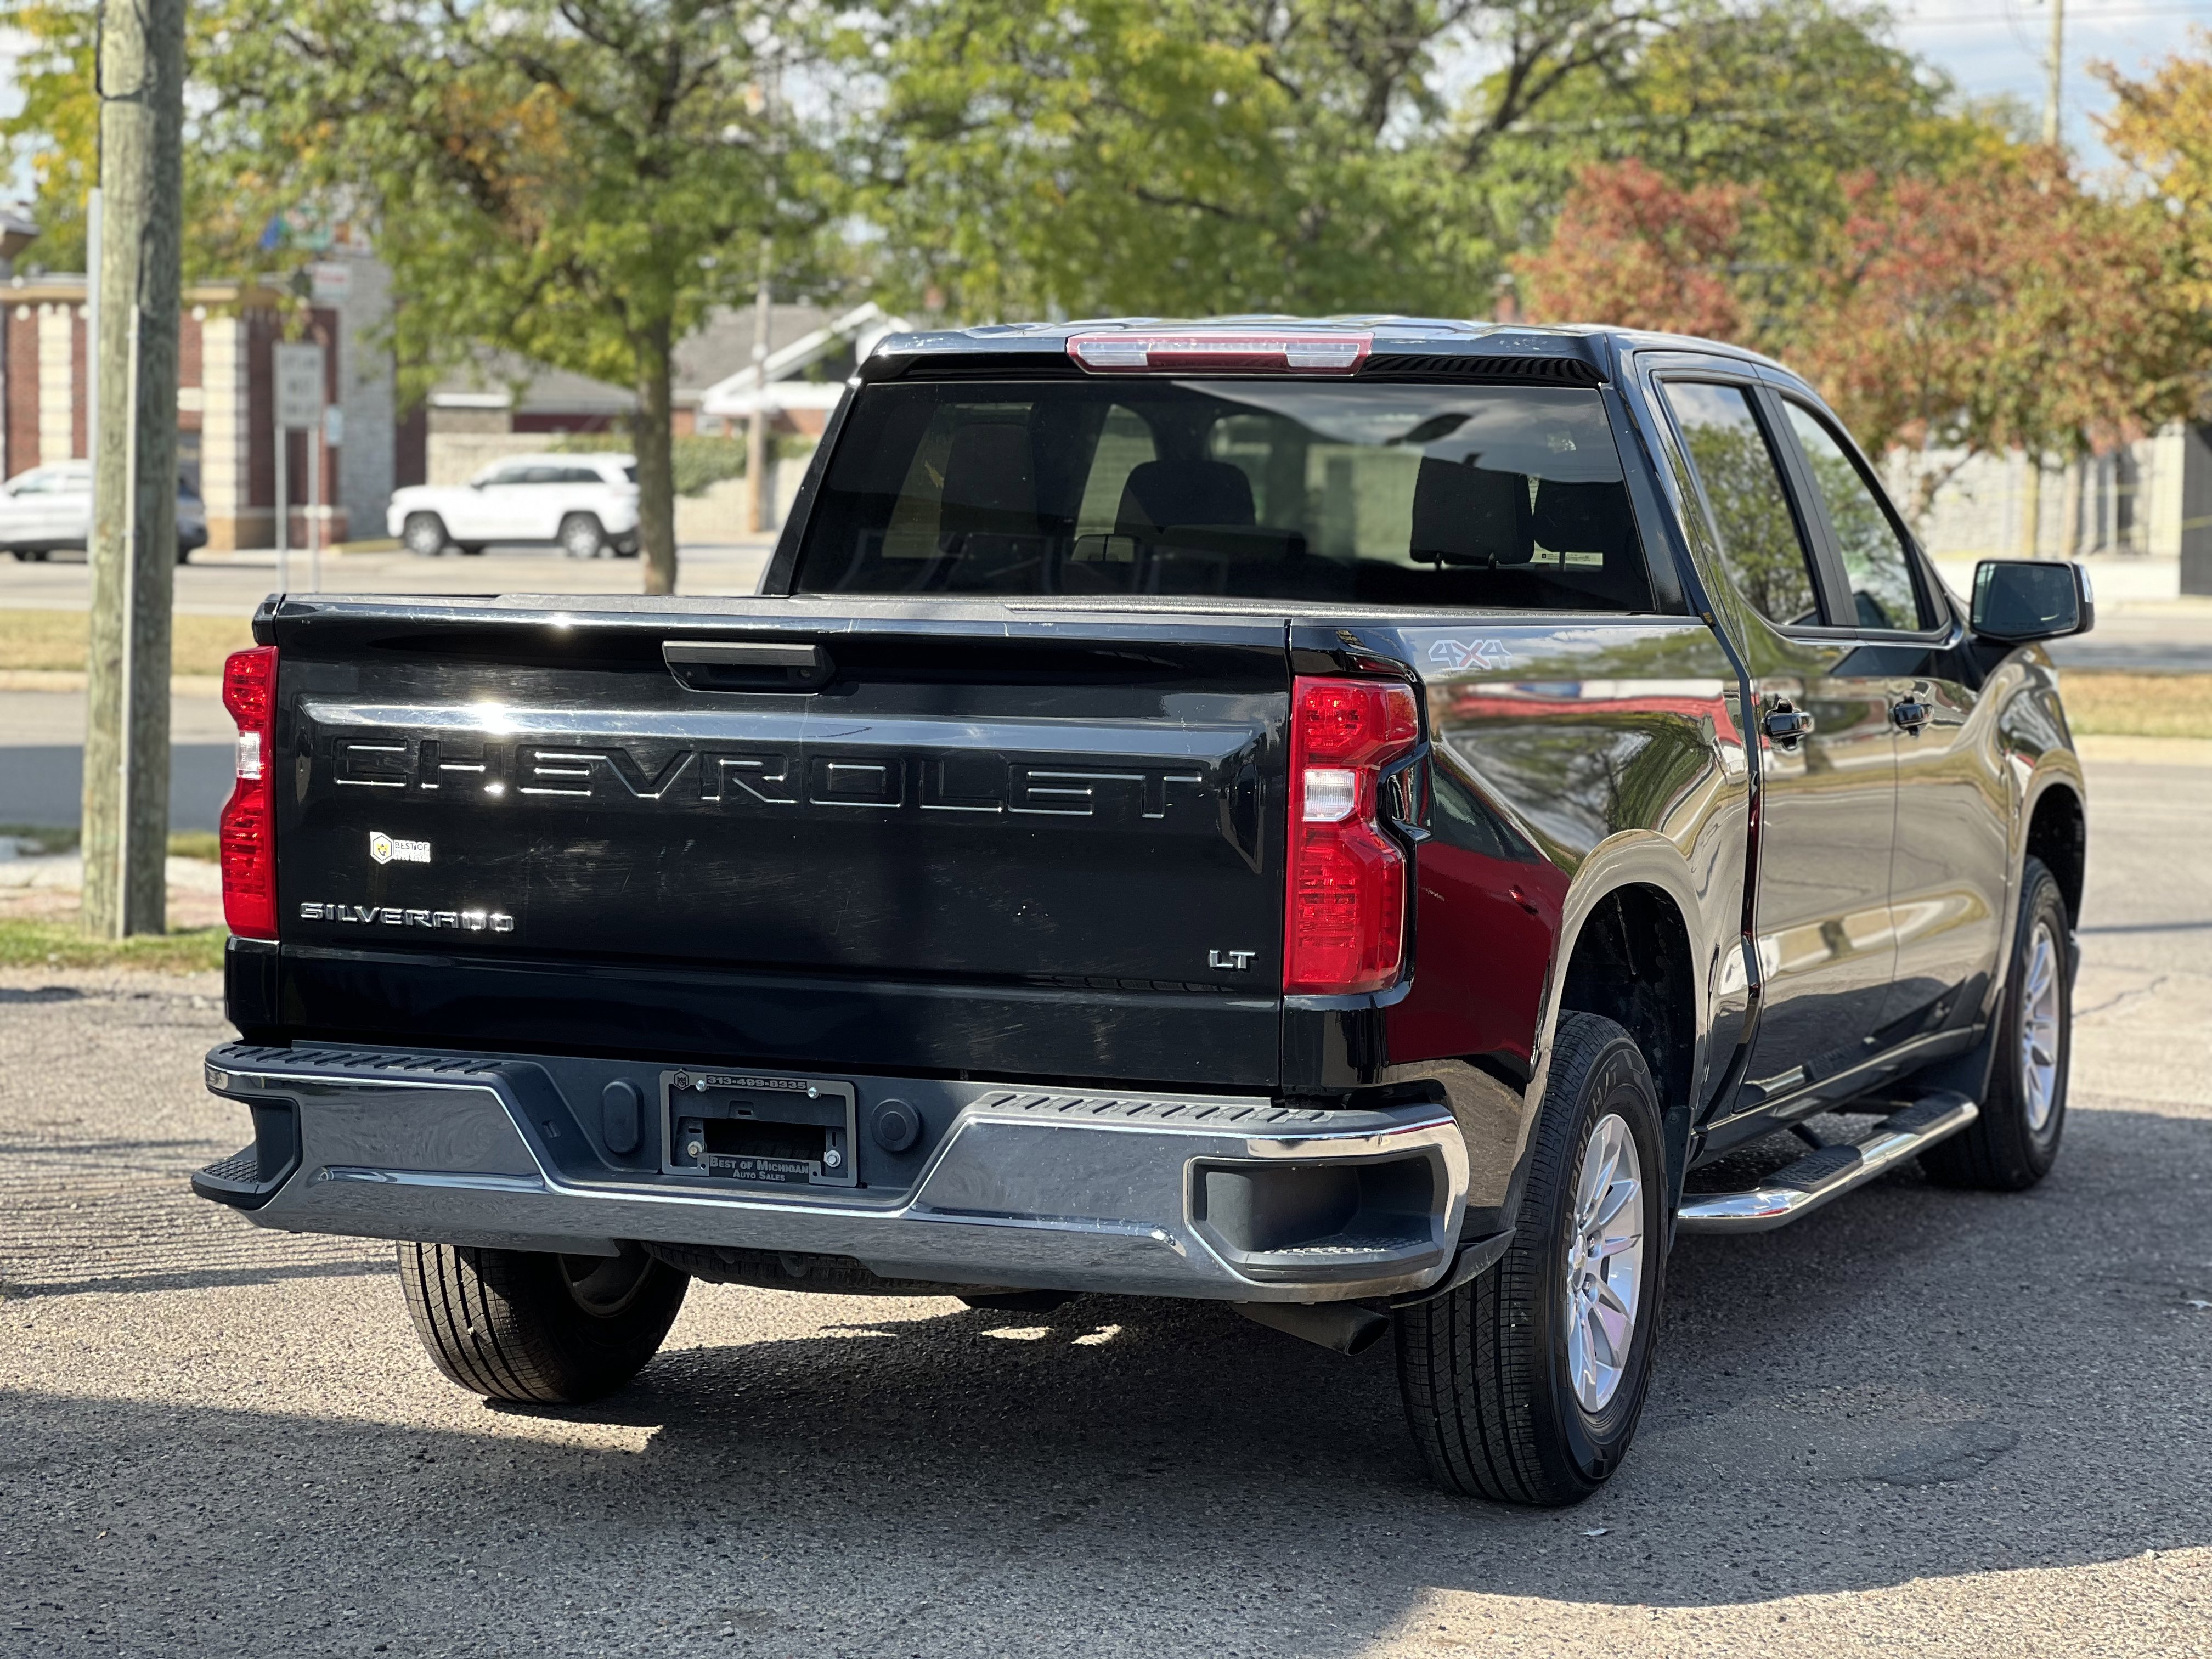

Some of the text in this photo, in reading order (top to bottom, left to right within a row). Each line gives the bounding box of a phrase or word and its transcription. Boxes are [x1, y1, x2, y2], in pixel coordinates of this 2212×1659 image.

[1428, 639, 1512, 670] 4X4
[332, 737, 1203, 819] CHEVROLET
[300, 901, 515, 932] SILVERADO
[1209, 950, 1256, 969] LT
[707, 1076, 807, 1090] 313-409-8335
[1569, 1115, 1592, 1201] PRO
